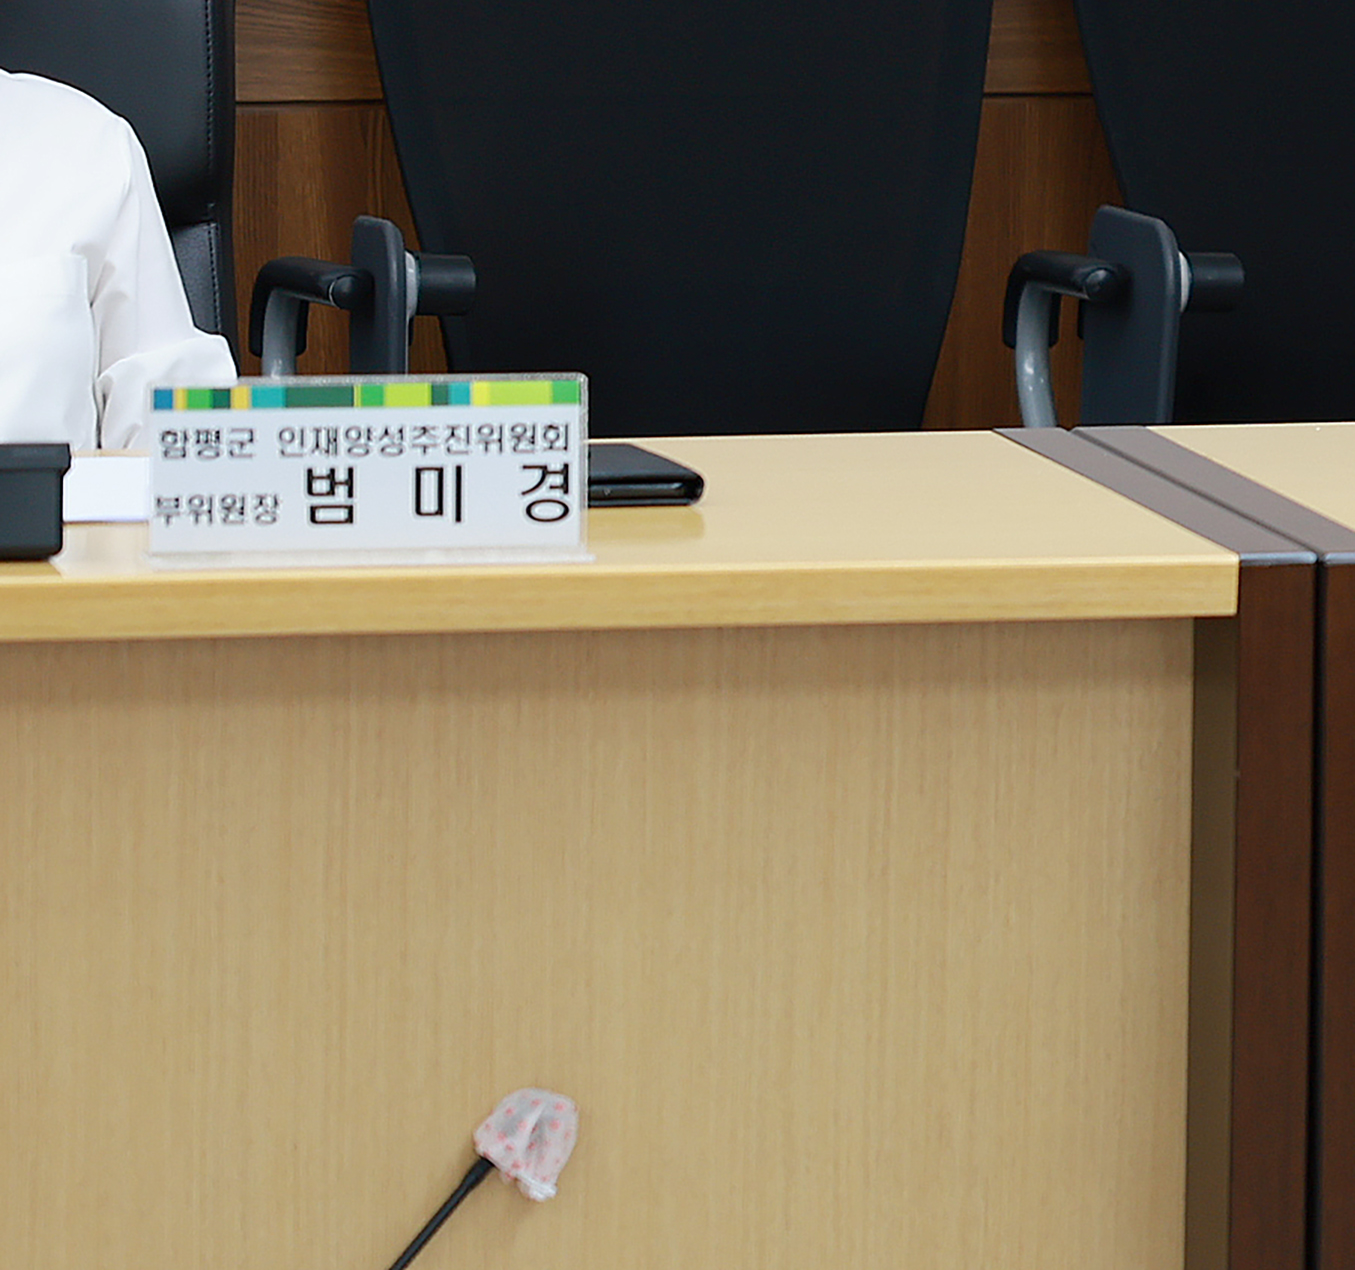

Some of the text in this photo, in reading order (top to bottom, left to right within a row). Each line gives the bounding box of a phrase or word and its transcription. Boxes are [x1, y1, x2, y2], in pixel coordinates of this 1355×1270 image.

[159, 422, 571, 461] 함평군 인재양성추진위원회
[155, 493, 280, 526] 부위원장
